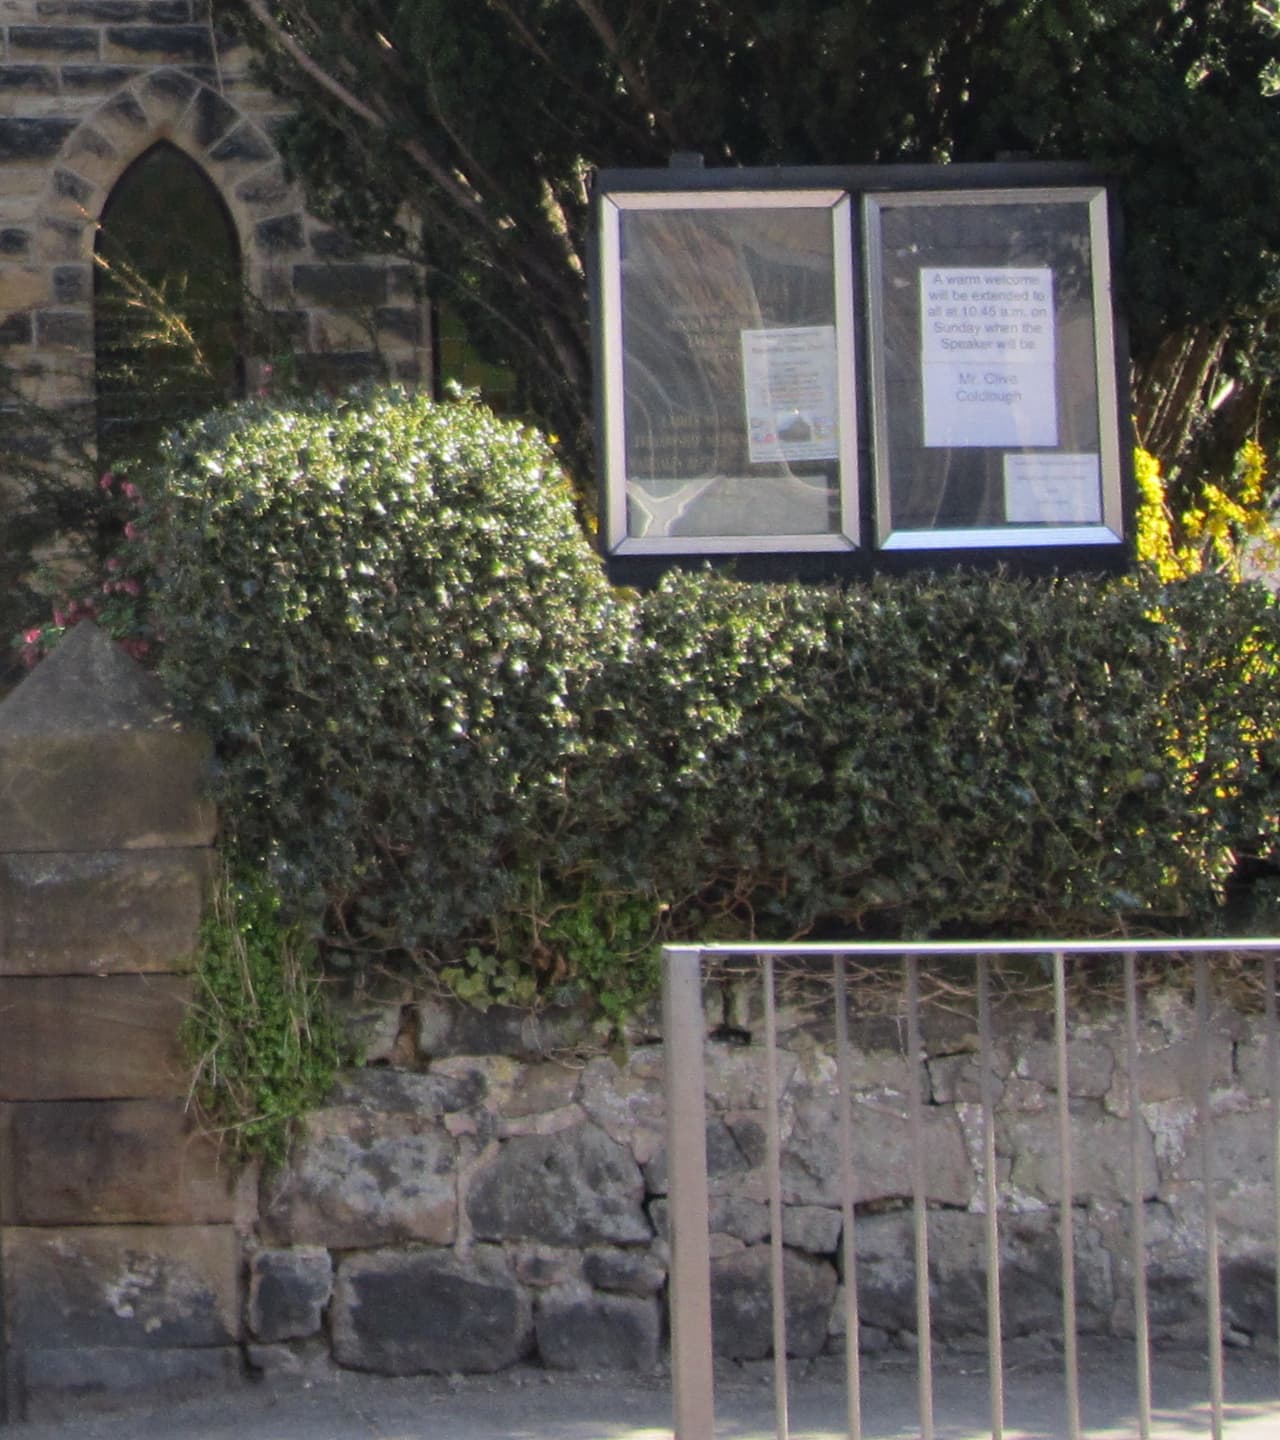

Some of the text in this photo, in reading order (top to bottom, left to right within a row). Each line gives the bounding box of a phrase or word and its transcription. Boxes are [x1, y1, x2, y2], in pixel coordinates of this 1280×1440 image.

[933, 273, 1040, 285] A warm welcome
[928, 290, 1046, 301] will be extended to
[927, 306, 942, 317] all
[945, 307, 957, 317] at
[1031, 307, 1048, 317] on
[933, 321, 1042, 335] Sunday when the
[940, 337, 1037, 351] Speaker will be
[983, 371, 1019, 385] Clive
